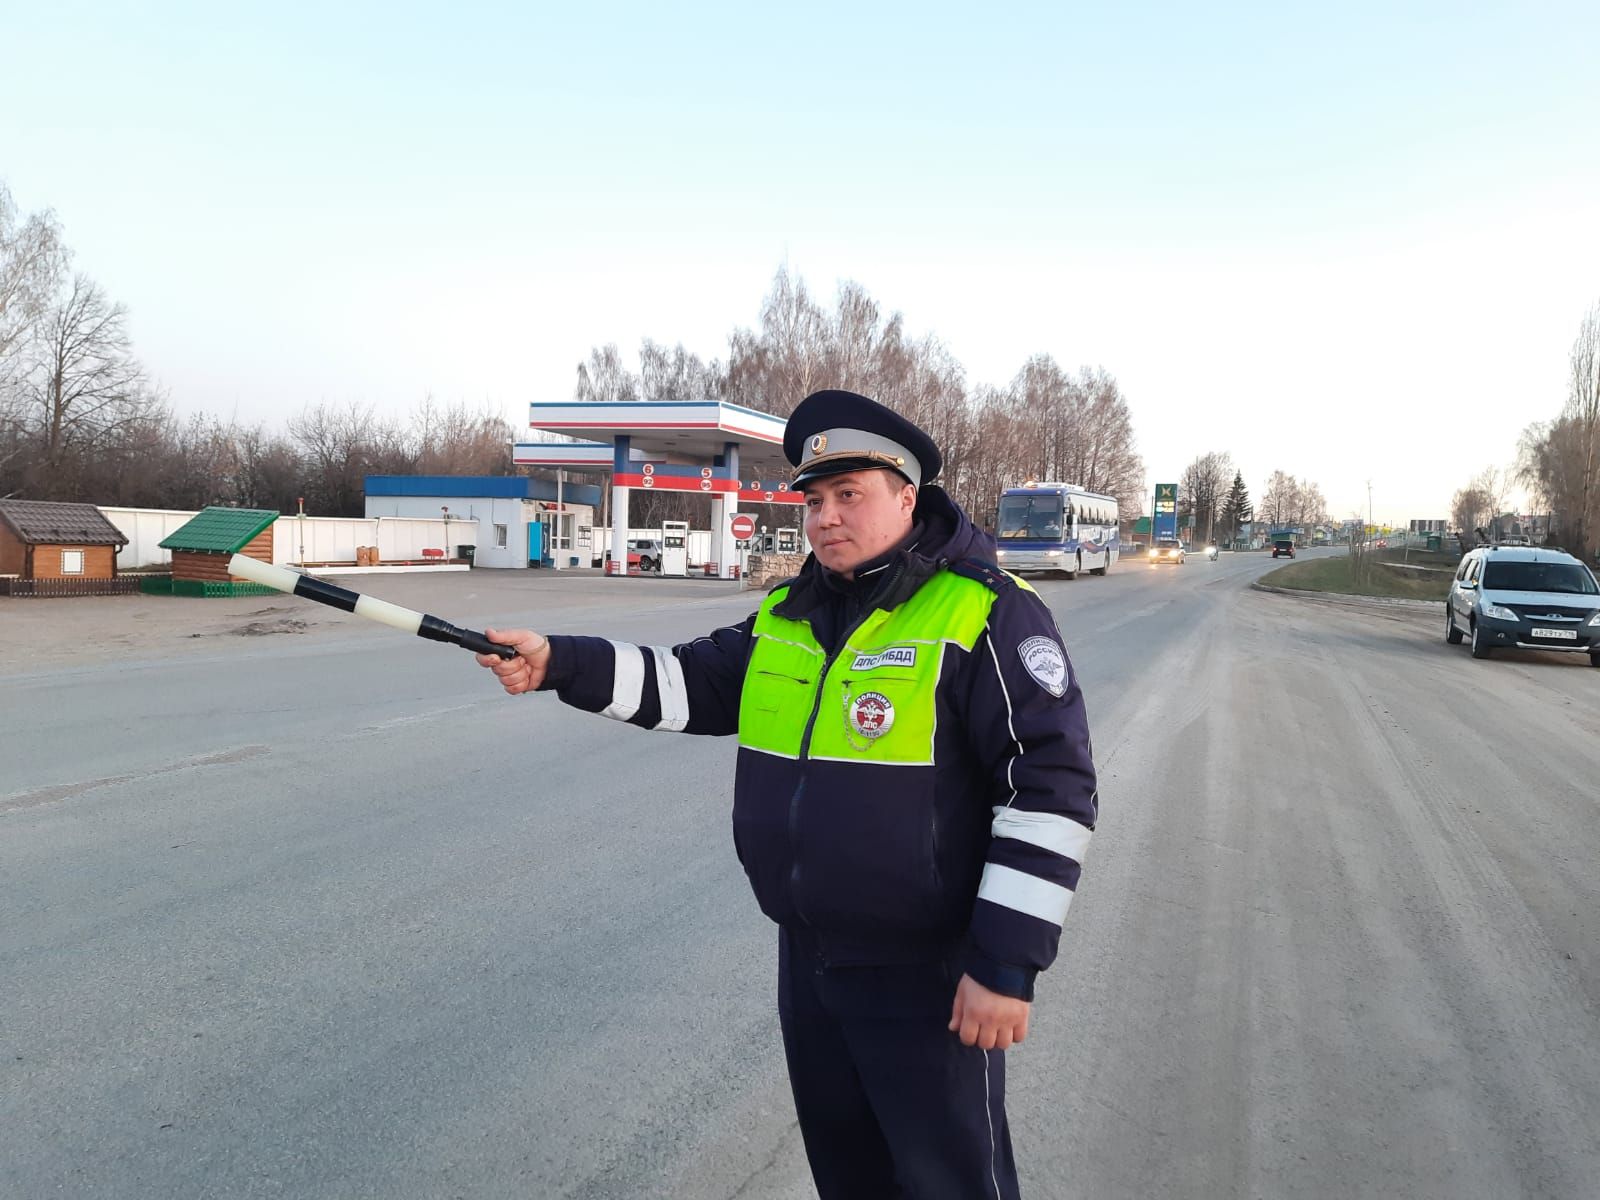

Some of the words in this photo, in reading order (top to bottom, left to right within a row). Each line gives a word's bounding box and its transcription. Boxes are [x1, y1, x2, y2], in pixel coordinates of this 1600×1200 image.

[855, 657, 877, 667] ДПС
[856, 692, 891, 708] ПОЛИЦИЯ
[862, 720, 878, 729] ДПС
